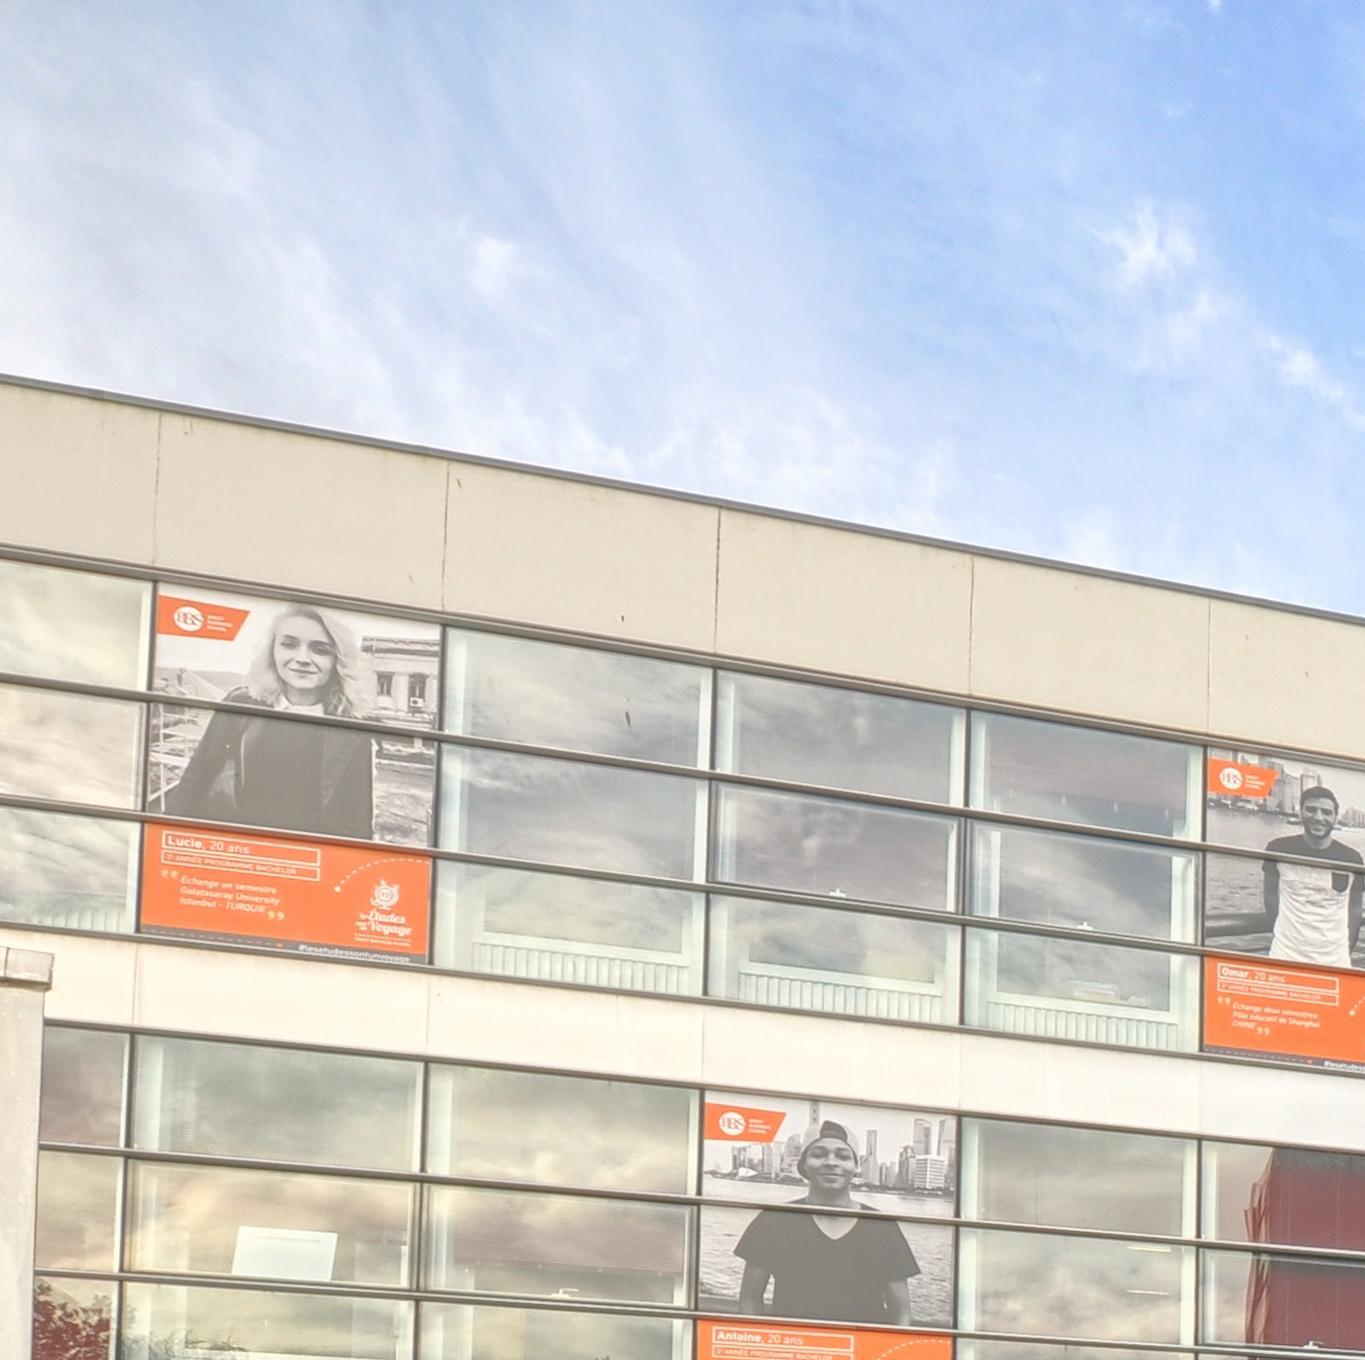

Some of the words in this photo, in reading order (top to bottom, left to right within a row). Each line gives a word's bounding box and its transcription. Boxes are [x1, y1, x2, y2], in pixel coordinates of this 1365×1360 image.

[167, 836, 206, 851] Lucie,
[210, 841, 225, 851] 20
[227, 845, 250, 854] ans
[204, 858, 253, 871] PROGRAMME
[256, 865, 297, 875] BACHELOR
[179, 887, 233, 901] Galatasaray
[235, 892, 280, 906] University
[235, 883, 277, 894] semestre
[179, 897, 217, 908] Istanbul
[226, 902, 267, 913] TURQUIE
[368, 921, 412, 936] Voyage
[1222, 967, 1252, 979] Omar,
[1254, 971, 1266, 981] 20
[1267, 974, 1286, 983] ans
[717, 1330, 765, 1344] Antoine,
[767, 1334, 781, 1344] 20
[783, 1337, 804, 1345] ans
[751, 1350, 795, 1360] PROGRAMME
[796, 1353, 833, 1360] BACHELOR
